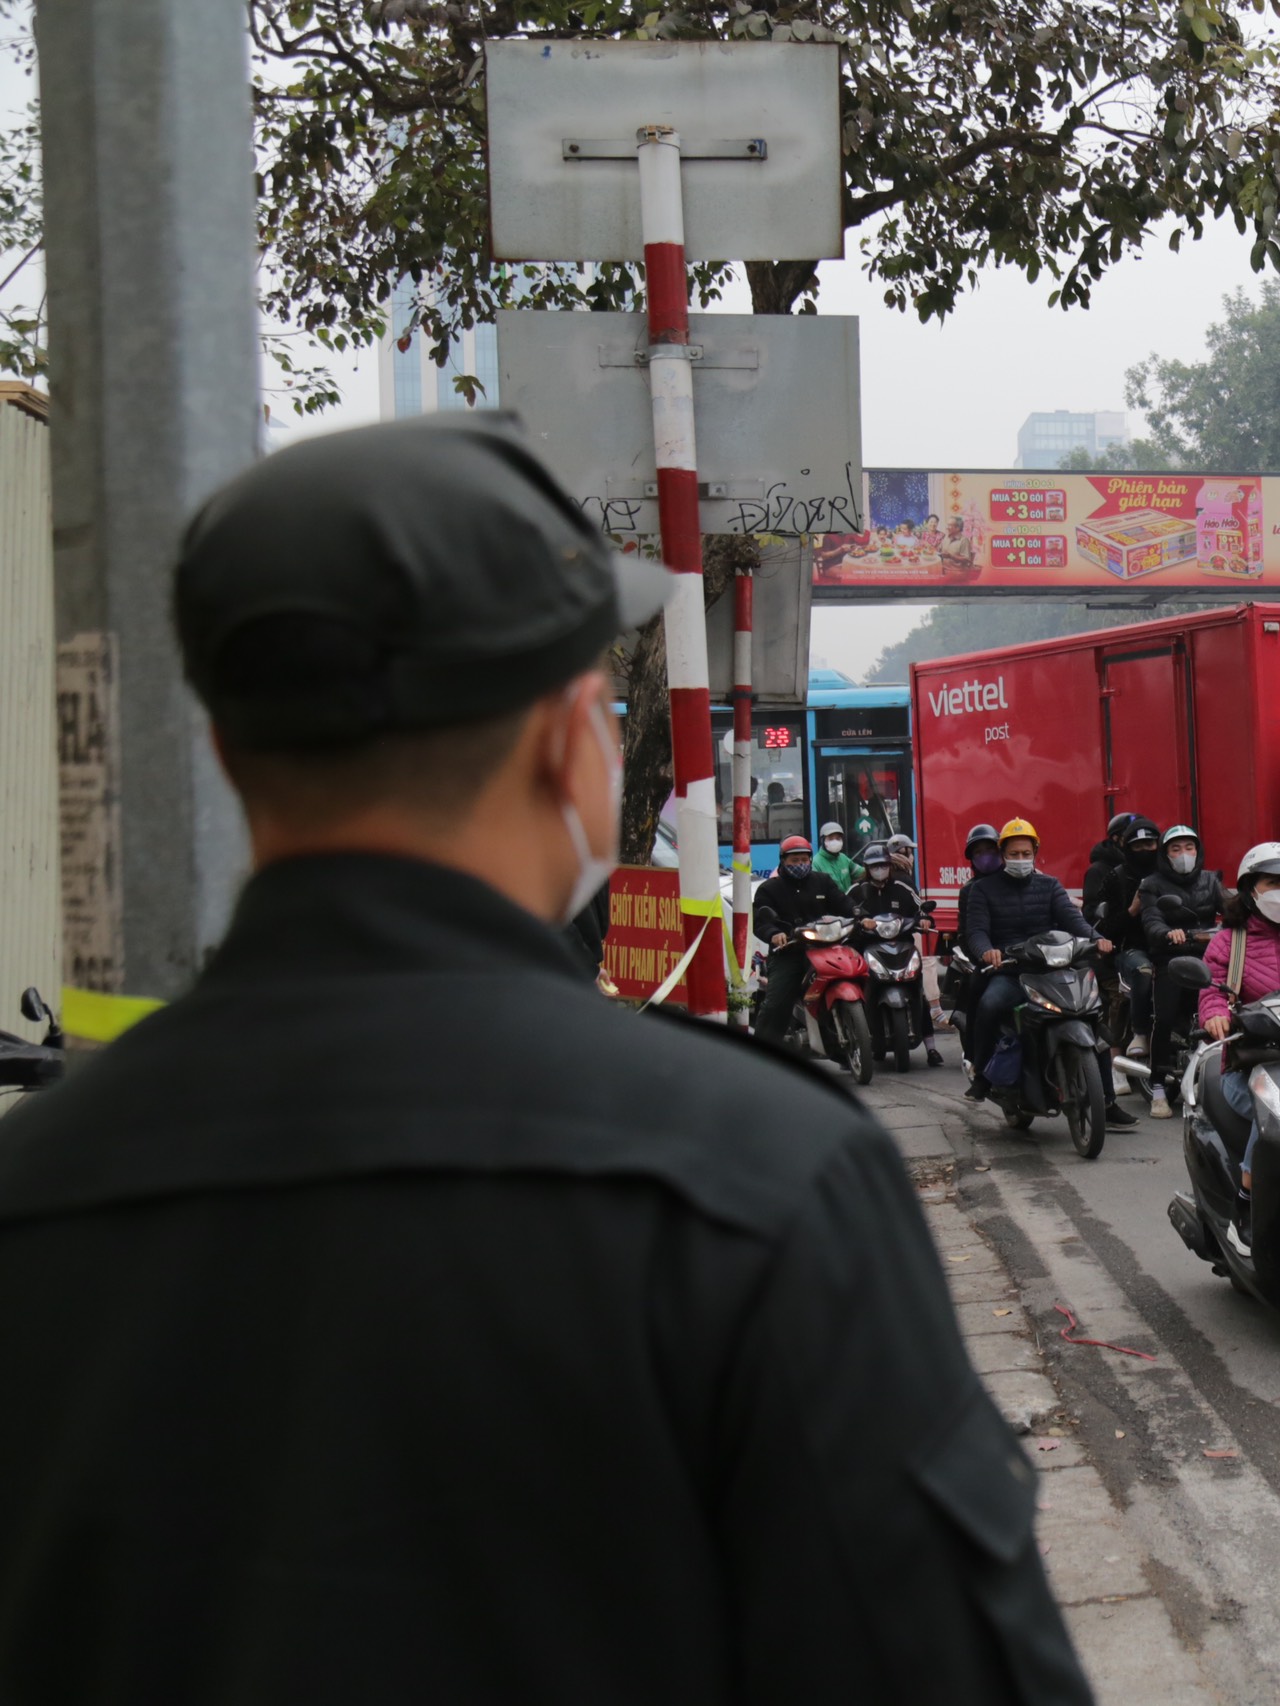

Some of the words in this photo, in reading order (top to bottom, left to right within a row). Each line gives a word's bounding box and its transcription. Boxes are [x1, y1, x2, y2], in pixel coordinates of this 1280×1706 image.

[1107, 478, 1155, 495] Phiên
[1157, 478, 1188, 495] bản
[992, 493, 1010, 502] MUA
[1011, 491, 1028, 502] 30
[1119, 494, 1148, 512] giới
[1151, 494, 1183, 512] hạn
[992, 539, 1011, 548] MUA
[1011, 537, 1026, 548] 10
[928, 676, 1008, 717] viettel
[764, 727, 790, 748] 28
[841, 727, 857, 737] CỬA
[858, 727, 873, 736] LÊN
[985, 722, 1010, 744] post
[611, 881, 633, 928] CHỐT
[634, 881, 657, 930] KIỂM
[619, 945, 628, 979] VI
[630, 947, 655, 989] PHẠM
